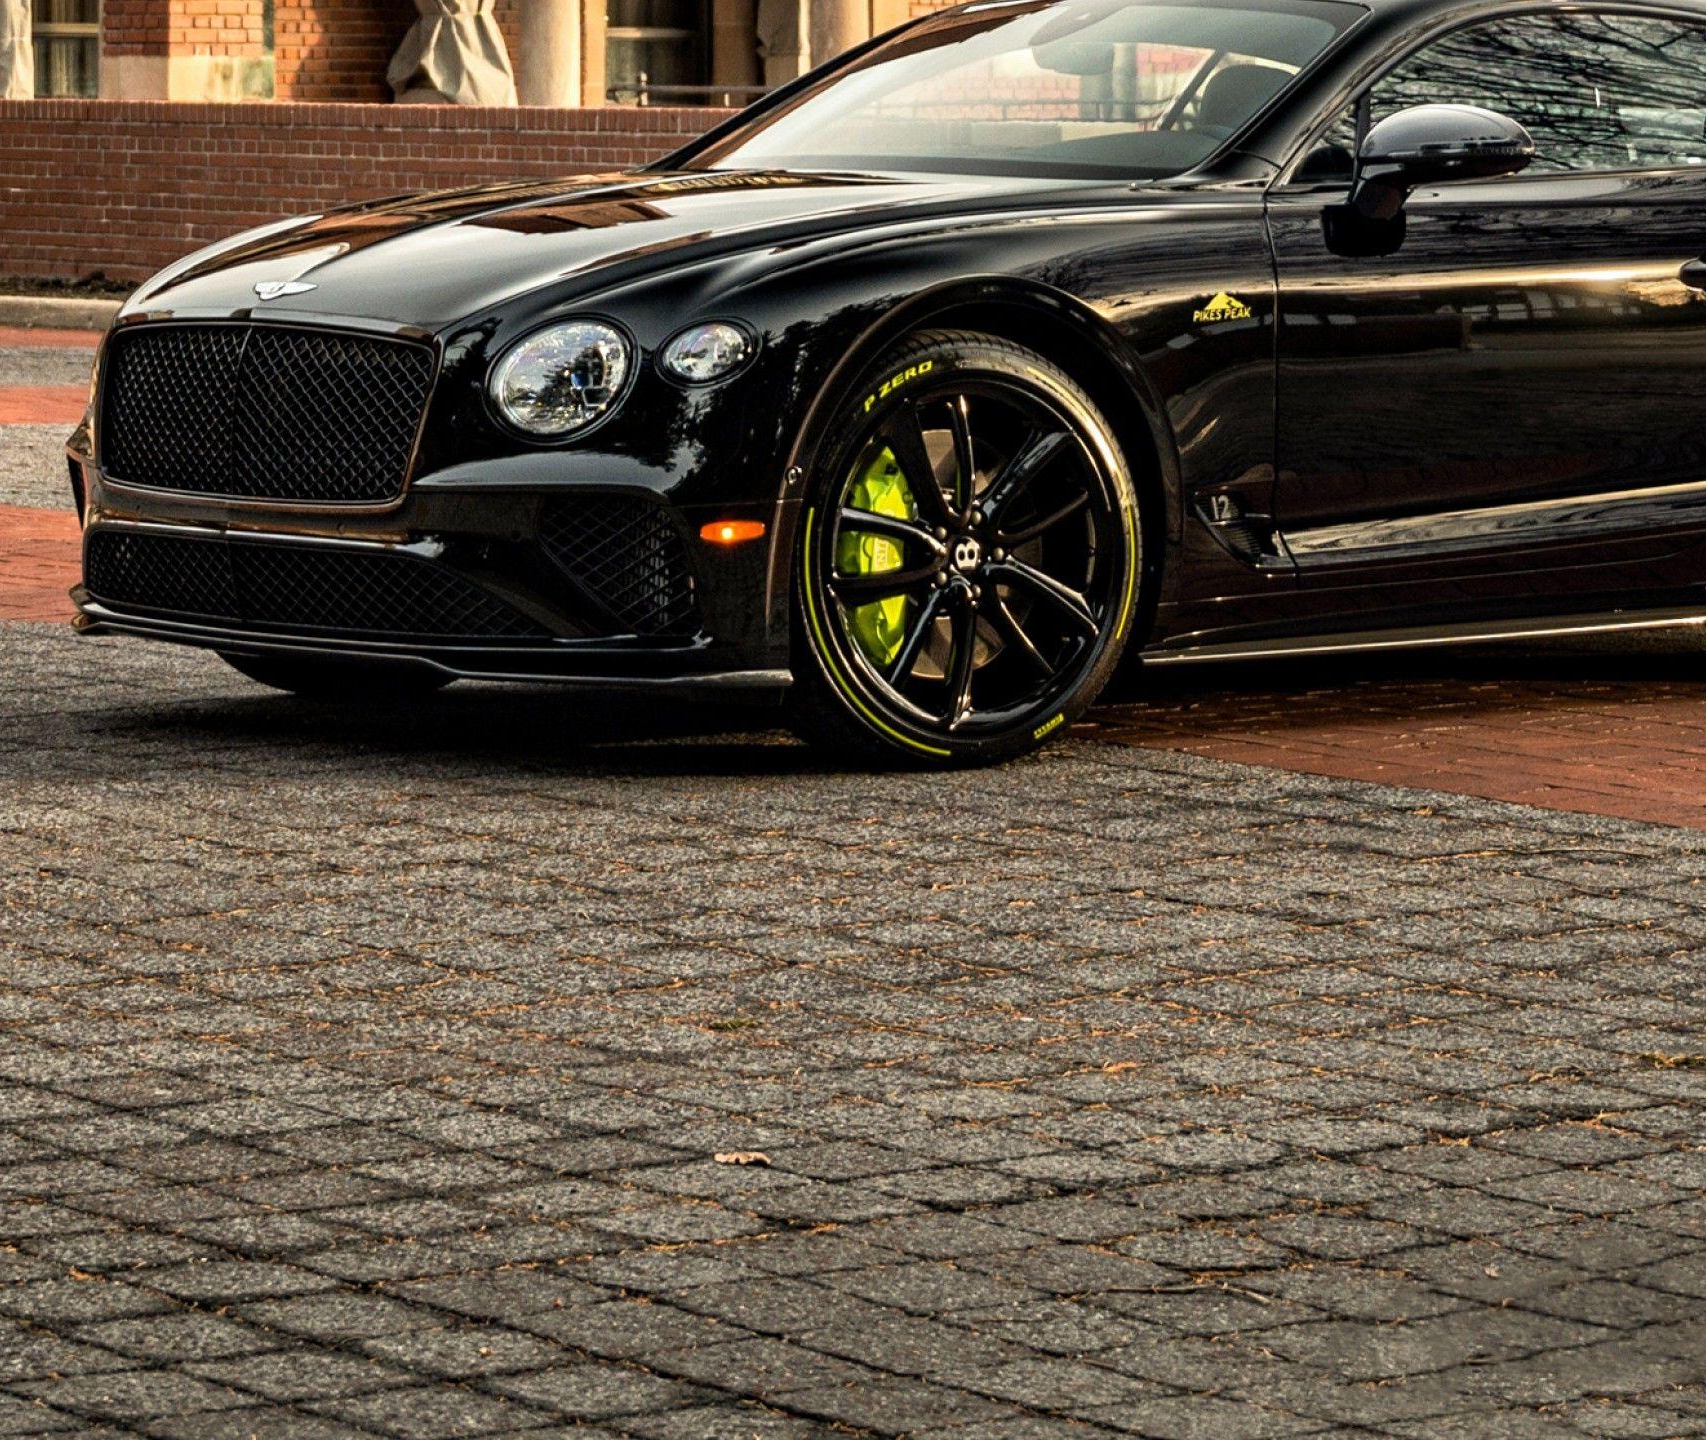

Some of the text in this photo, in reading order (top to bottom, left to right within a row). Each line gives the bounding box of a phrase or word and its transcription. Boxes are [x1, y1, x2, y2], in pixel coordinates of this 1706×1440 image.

[1193, 307, 1251, 322] PIKES PEAK
[864, 361, 932, 413] P ZERO
[1211, 495, 1231, 520] 12
